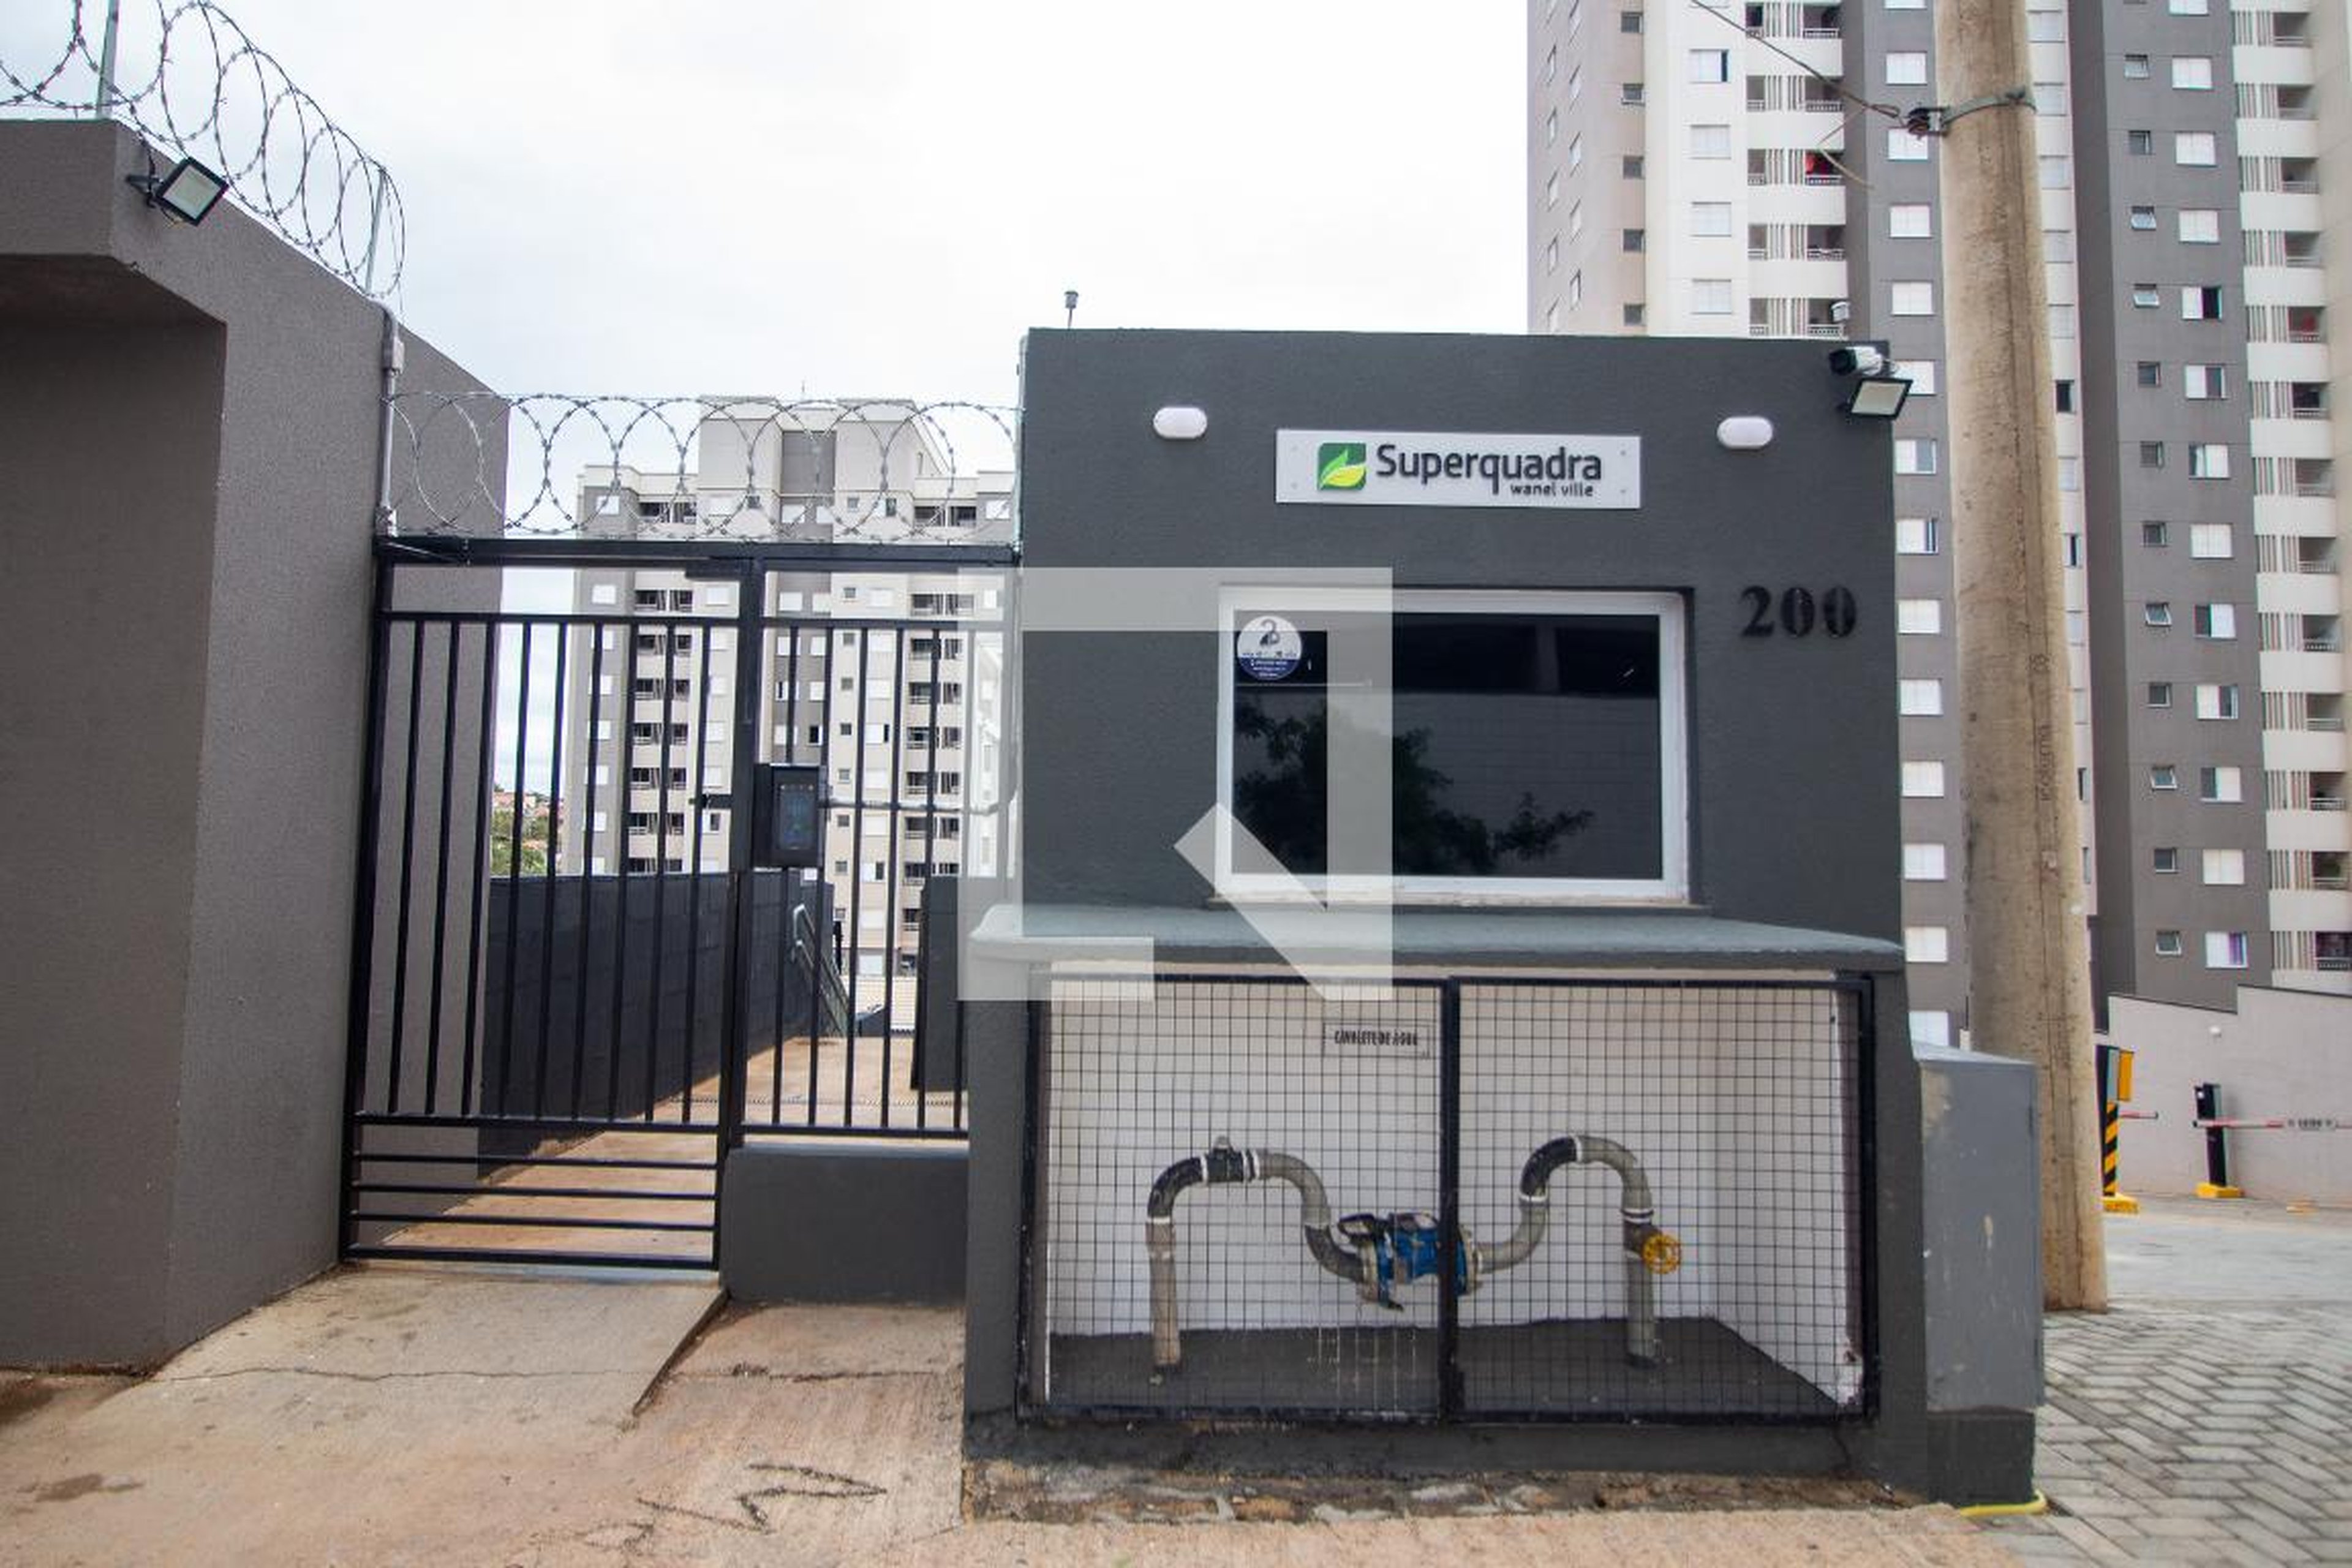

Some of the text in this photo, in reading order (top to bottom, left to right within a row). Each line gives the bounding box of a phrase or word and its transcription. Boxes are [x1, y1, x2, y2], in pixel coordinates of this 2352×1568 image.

[1376, 443, 1602, 495] Superquadra
[1510, 482, 1594, 497] wanel ville
[1740, 585, 1857, 638] 200
